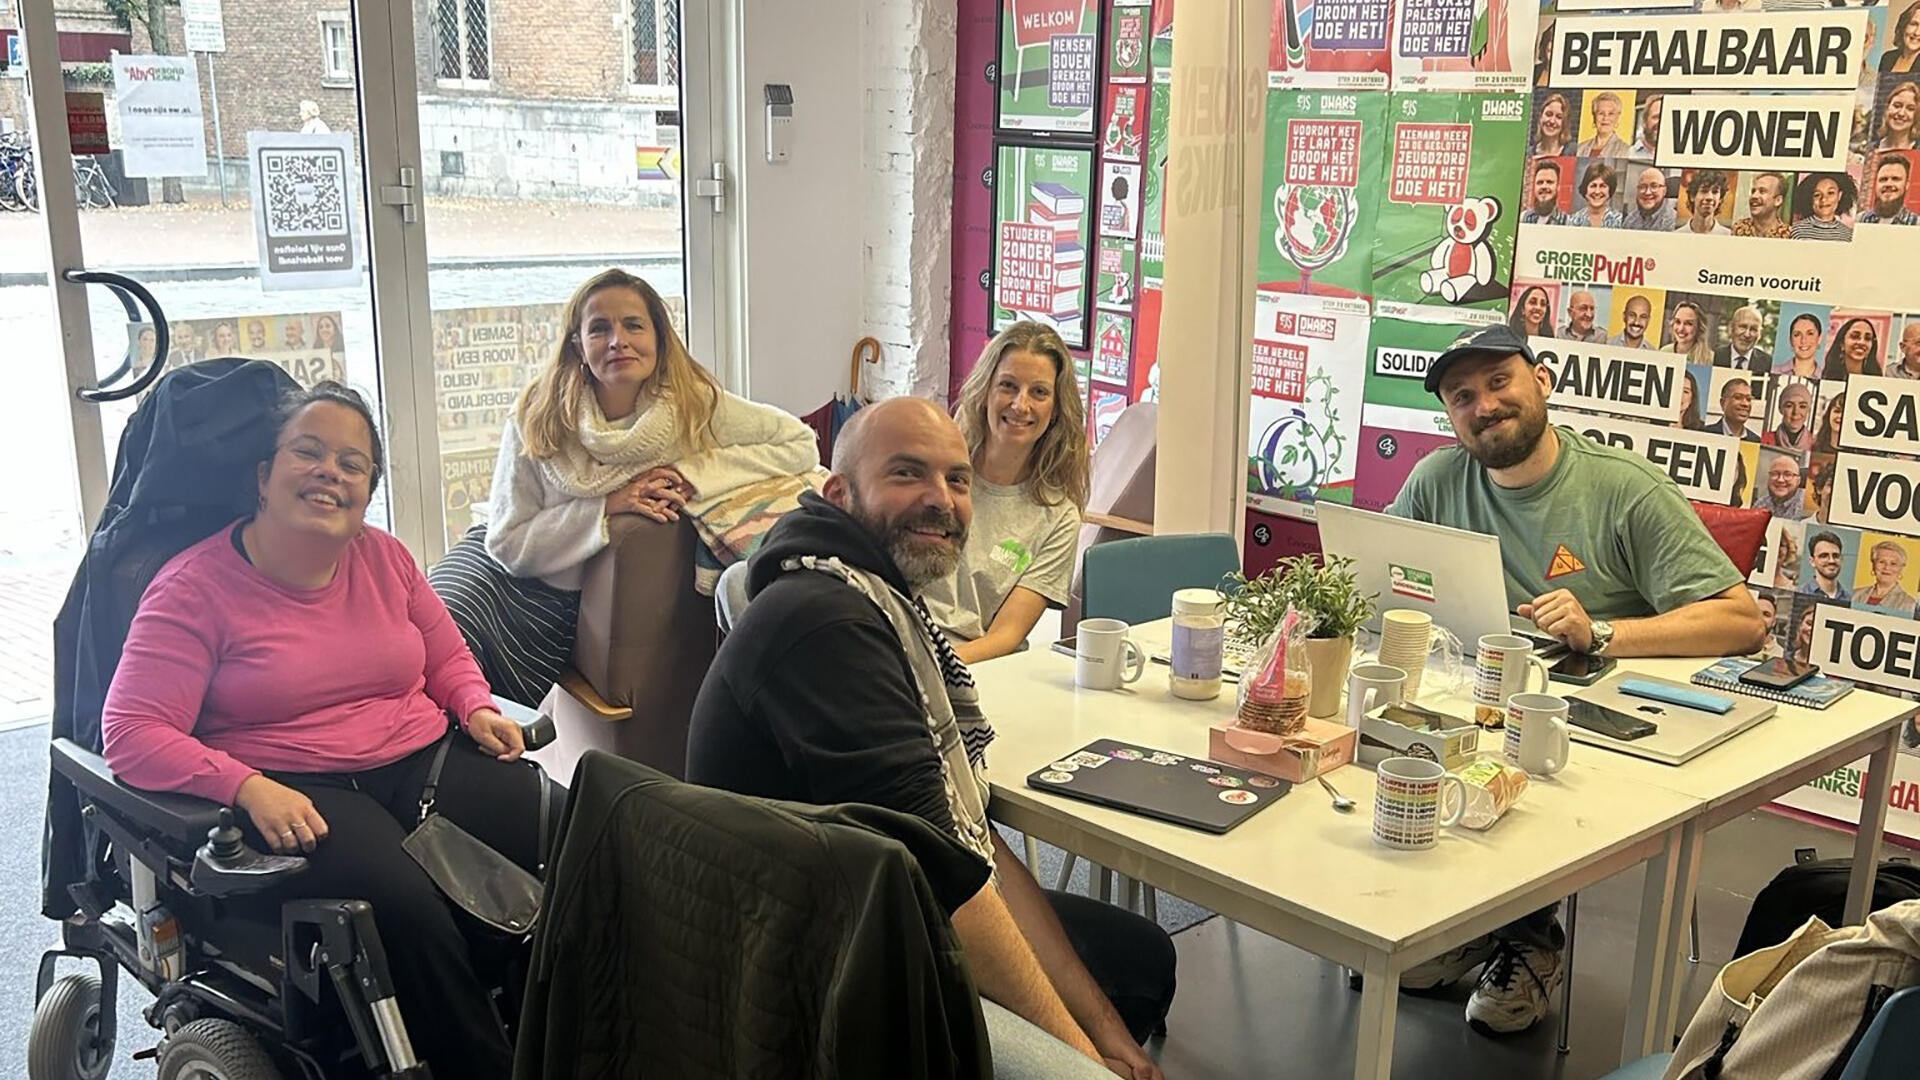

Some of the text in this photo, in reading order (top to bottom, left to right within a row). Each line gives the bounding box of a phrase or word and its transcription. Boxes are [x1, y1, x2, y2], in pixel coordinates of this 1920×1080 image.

[1022, 11, 1075, 29] WELKOM
[1316, 5, 1387, 20] DROOM HET
[1405, 8, 1471, 20] PALESTINA
[1314, 22, 1384, 39] DOE HET!
[1404, 22, 1470, 35] DROOM HET
[1053, 39, 1092, 52] MENSEN
[1403, 37, 1466, 52] DOE HET!
[1561, 27, 1852, 76] BETAALBAAR
[1052, 53, 1091, 68] BOVEN
[1052, 70, 1091, 82] GRENZEN
[1077, 82, 1090, 93] HET
[1052, 92, 1068, 104] DOE
[1320, 95, 1356, 110] DWARS
[1482, 100, 1523, 115] DWARS
[1293, 125, 1357, 137] VOORDAT HET
[1400, 130, 1468, 141] NIEMAND MEER
[1671, 110, 1841, 158] WONEN
[1292, 136, 1355, 150] TE LAAT IS
[1400, 140, 1467, 151] IN DE GESLOTEN
[1291, 150, 1354, 165] DROOM HET
[1398, 151, 1466, 165] JEUGDZORG
[1289, 164, 1353, 182] DOE HET!
[1397, 165, 1464, 180] DROOM HET
[1395, 180, 1460, 198] DOE HET!
[1003, 226, 1053, 241] STUDEREN
[1003, 241, 1052, 261] ZONDER
[1536, 250, 1593, 267] GROEN
[1002, 260, 1051, 280] SCHULD
[1543, 265, 1592, 282] LINKS
[1593, 254, 1644, 286] PvdA
[1002, 276, 1051, 294] DROOM HET
[1697, 268, 1821, 292] Samen vooruit
[1002, 290, 1051, 308] DOE HET!
[1300, 316, 1335, 334] DWARS
[1271, 347, 1304, 362] WERELD
[1382, 352, 1436, 374] SOLIDA
[1284, 369, 1303, 382] HET
[1536, 350, 1674, 408] SAMEN
[1275, 380, 1302, 397] HET!
[1847, 468, 1920, 520] VO
